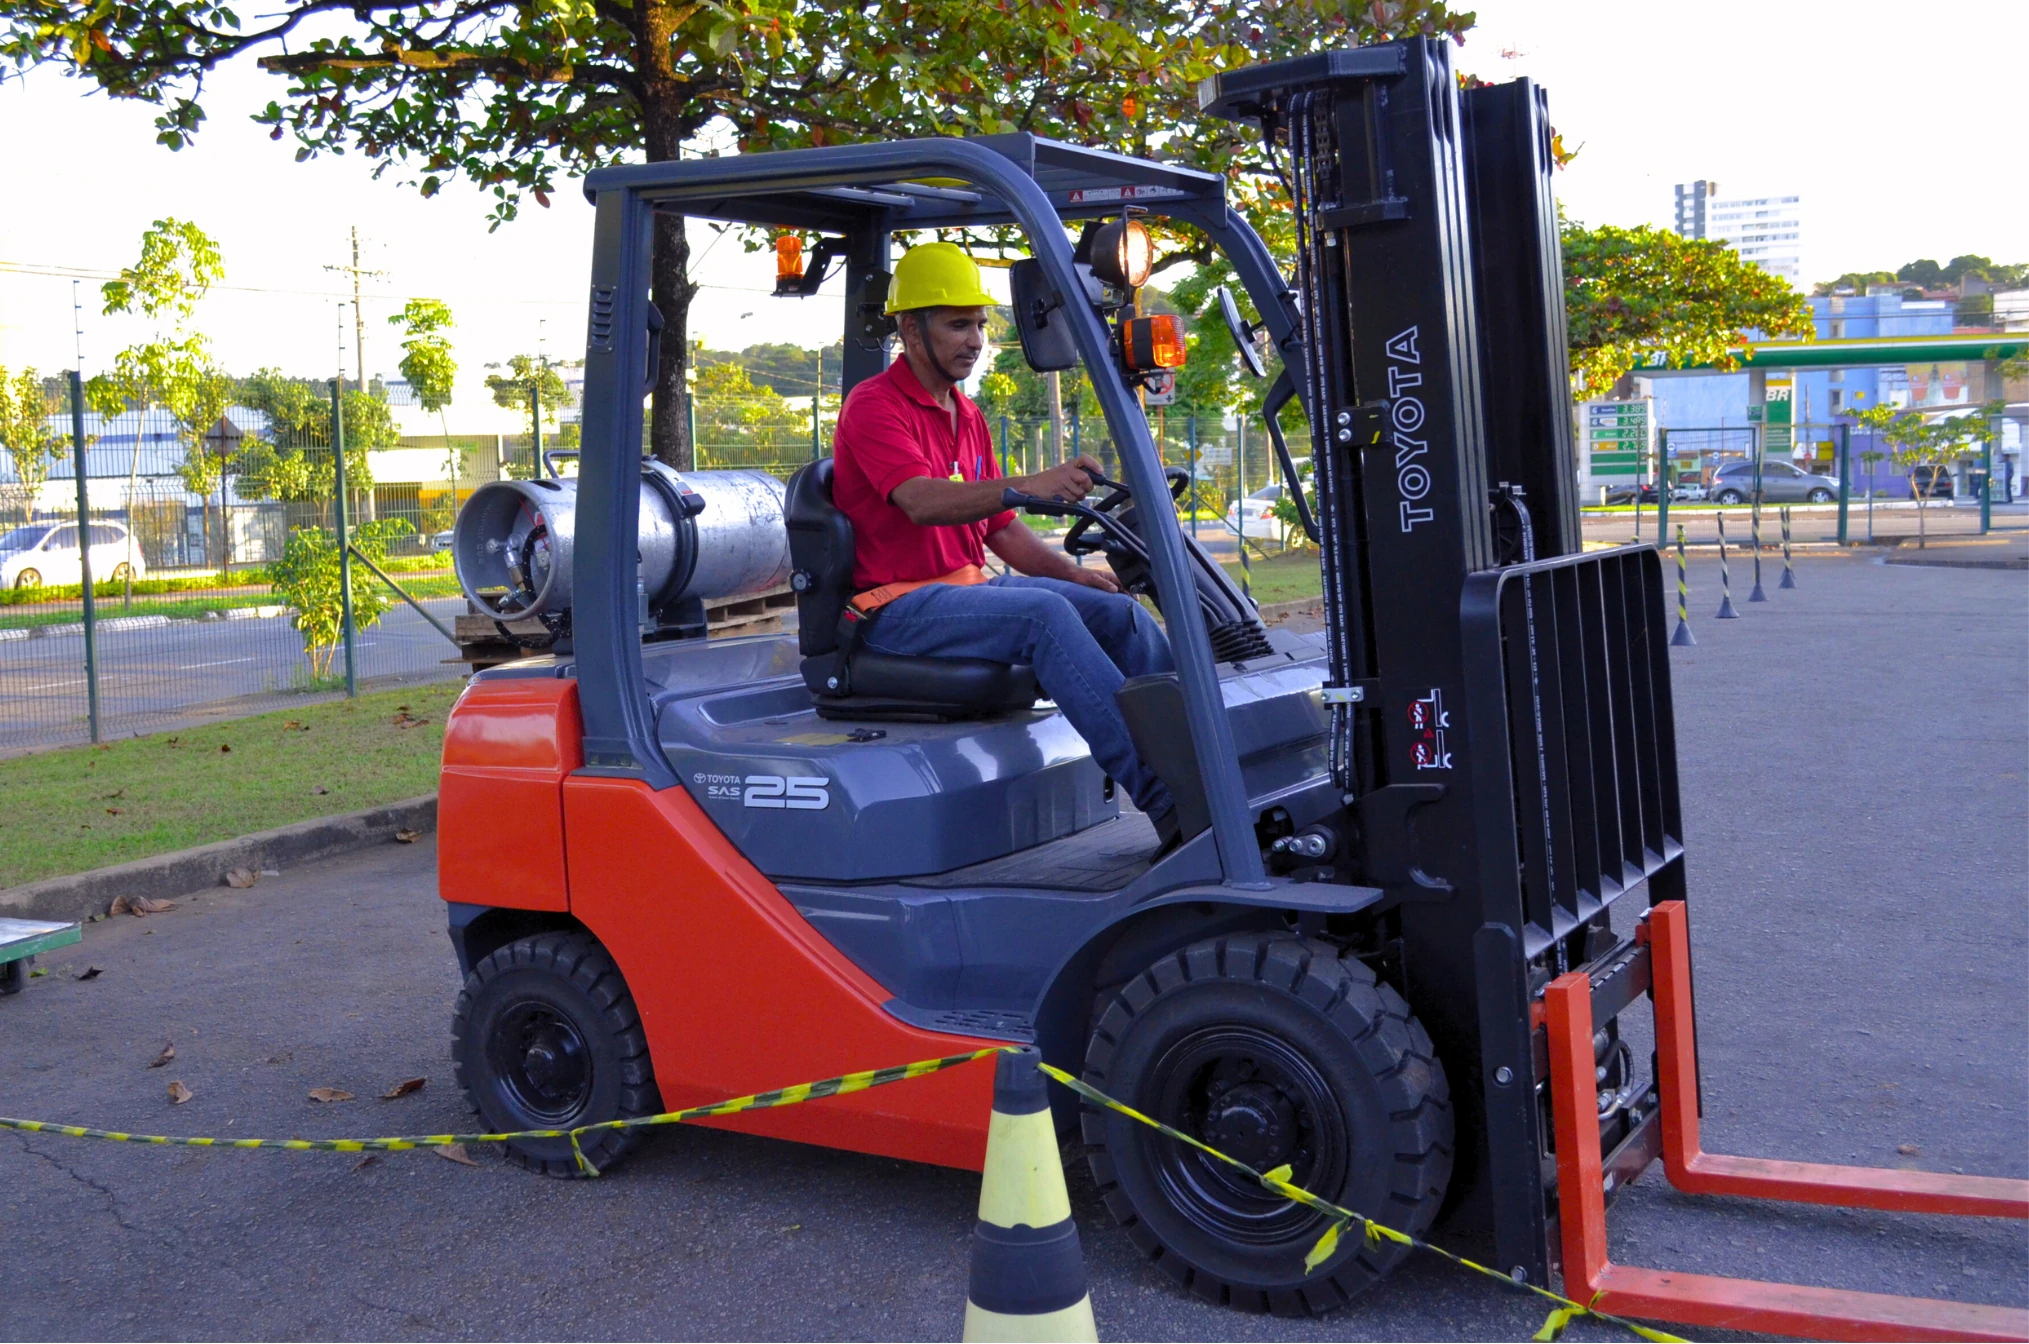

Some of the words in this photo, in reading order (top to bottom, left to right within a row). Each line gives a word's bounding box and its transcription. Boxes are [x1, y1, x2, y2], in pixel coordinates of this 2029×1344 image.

[1766, 389, 1788, 402] BR
[1386, 325, 1435, 533] TOYOTA
[707, 774, 740, 784] TOYOTA
[708, 786, 740, 796] SAS
[744, 775, 830, 810] 25
